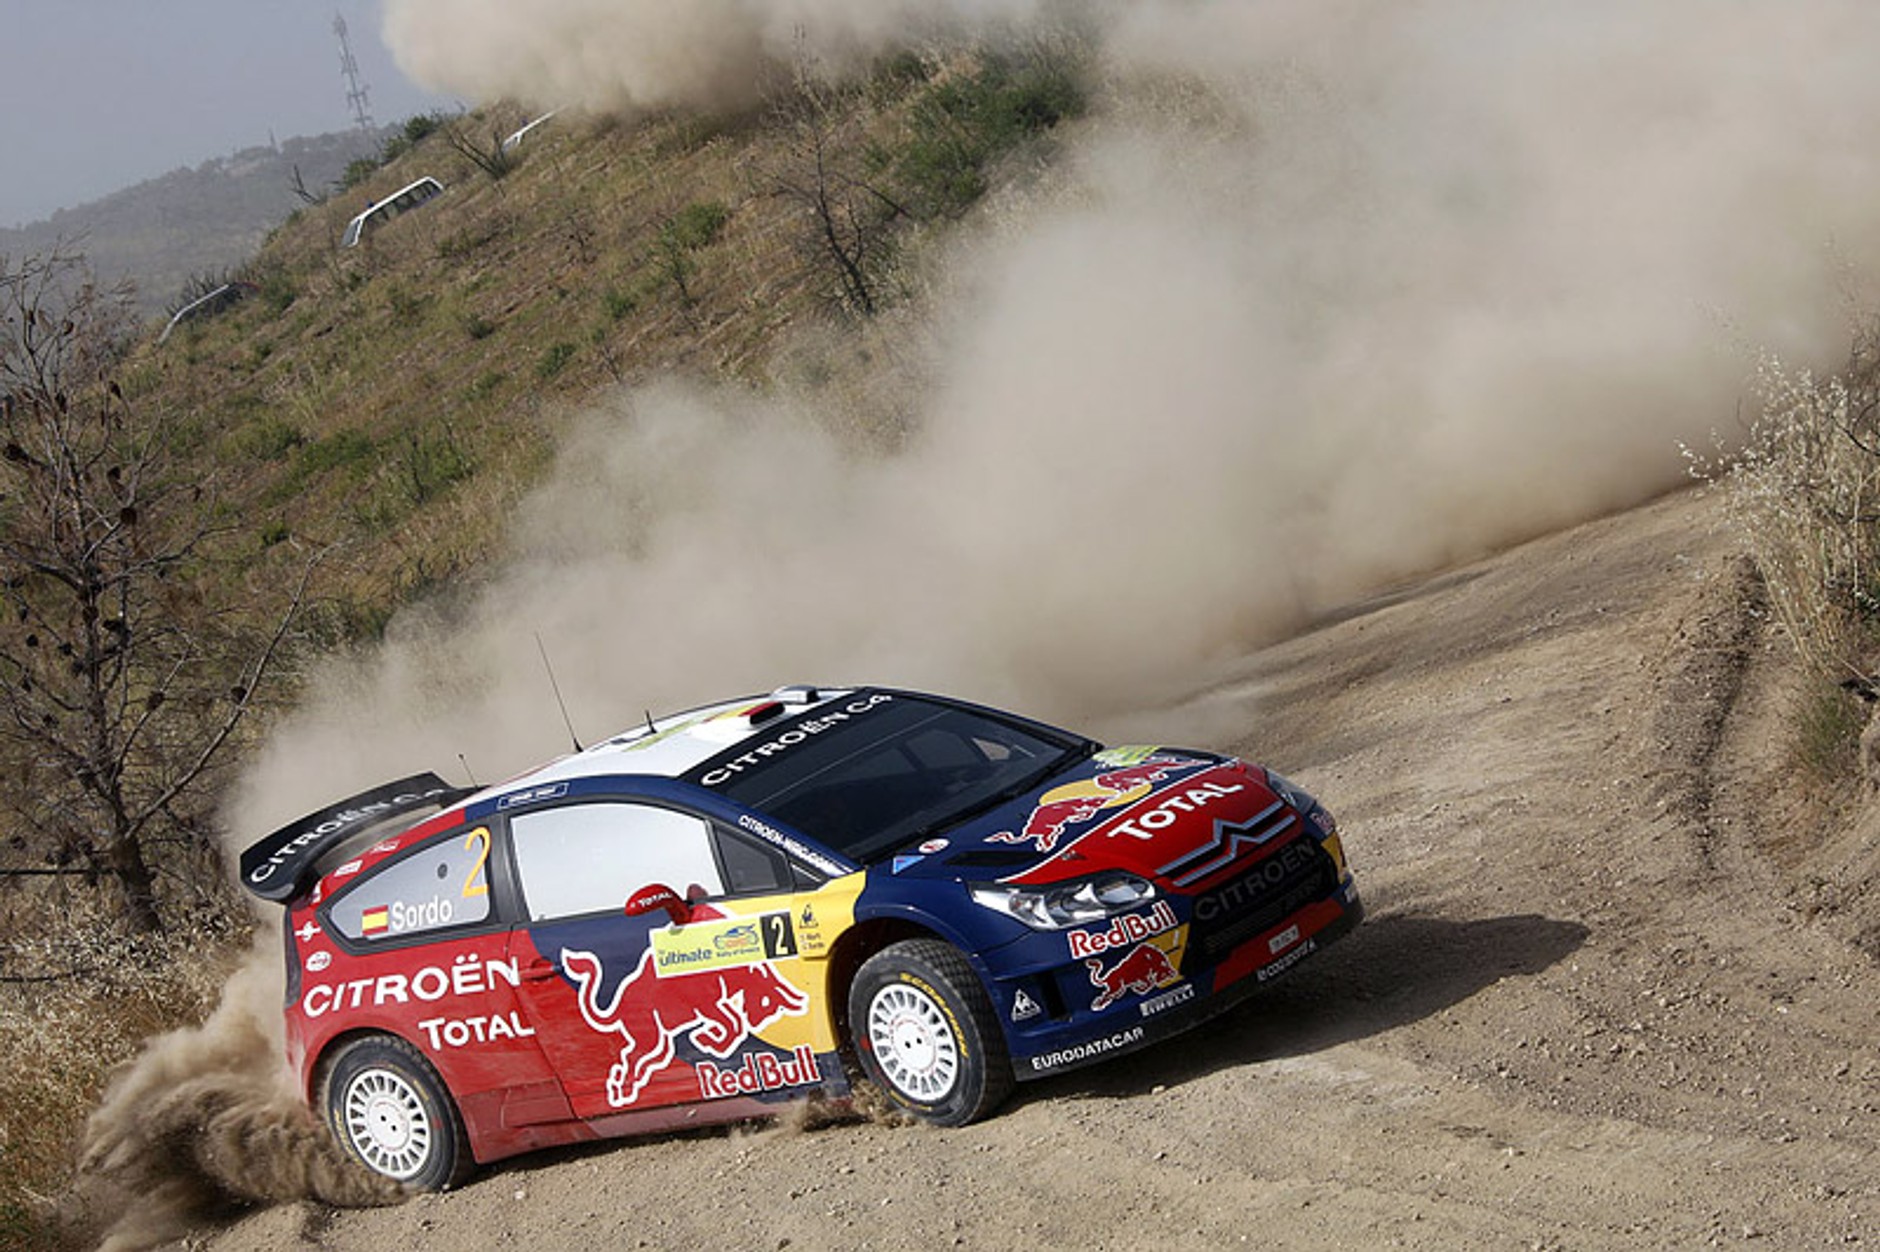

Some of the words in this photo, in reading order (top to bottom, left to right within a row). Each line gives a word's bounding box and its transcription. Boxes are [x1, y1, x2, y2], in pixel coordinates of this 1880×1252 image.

[847, 694, 892, 713] C4
[1107, 780, 1244, 840] TOTAL
[461, 826, 492, 898] 2
[391, 895, 453, 932] Sordo
[638, 891, 672, 907] TOTAL
[771, 915, 789, 956] 2
[1068, 917, 1128, 958] Red
[1123, 900, 1178, 942] Bull
[303, 953, 523, 1018] CITROËN
[418, 1010, 535, 1051] TOTAL
[1031, 1026, 1144, 1071] EURODATACAR
[697, 1053, 760, 1098] Red
[756, 1044, 821, 1090] Bull
